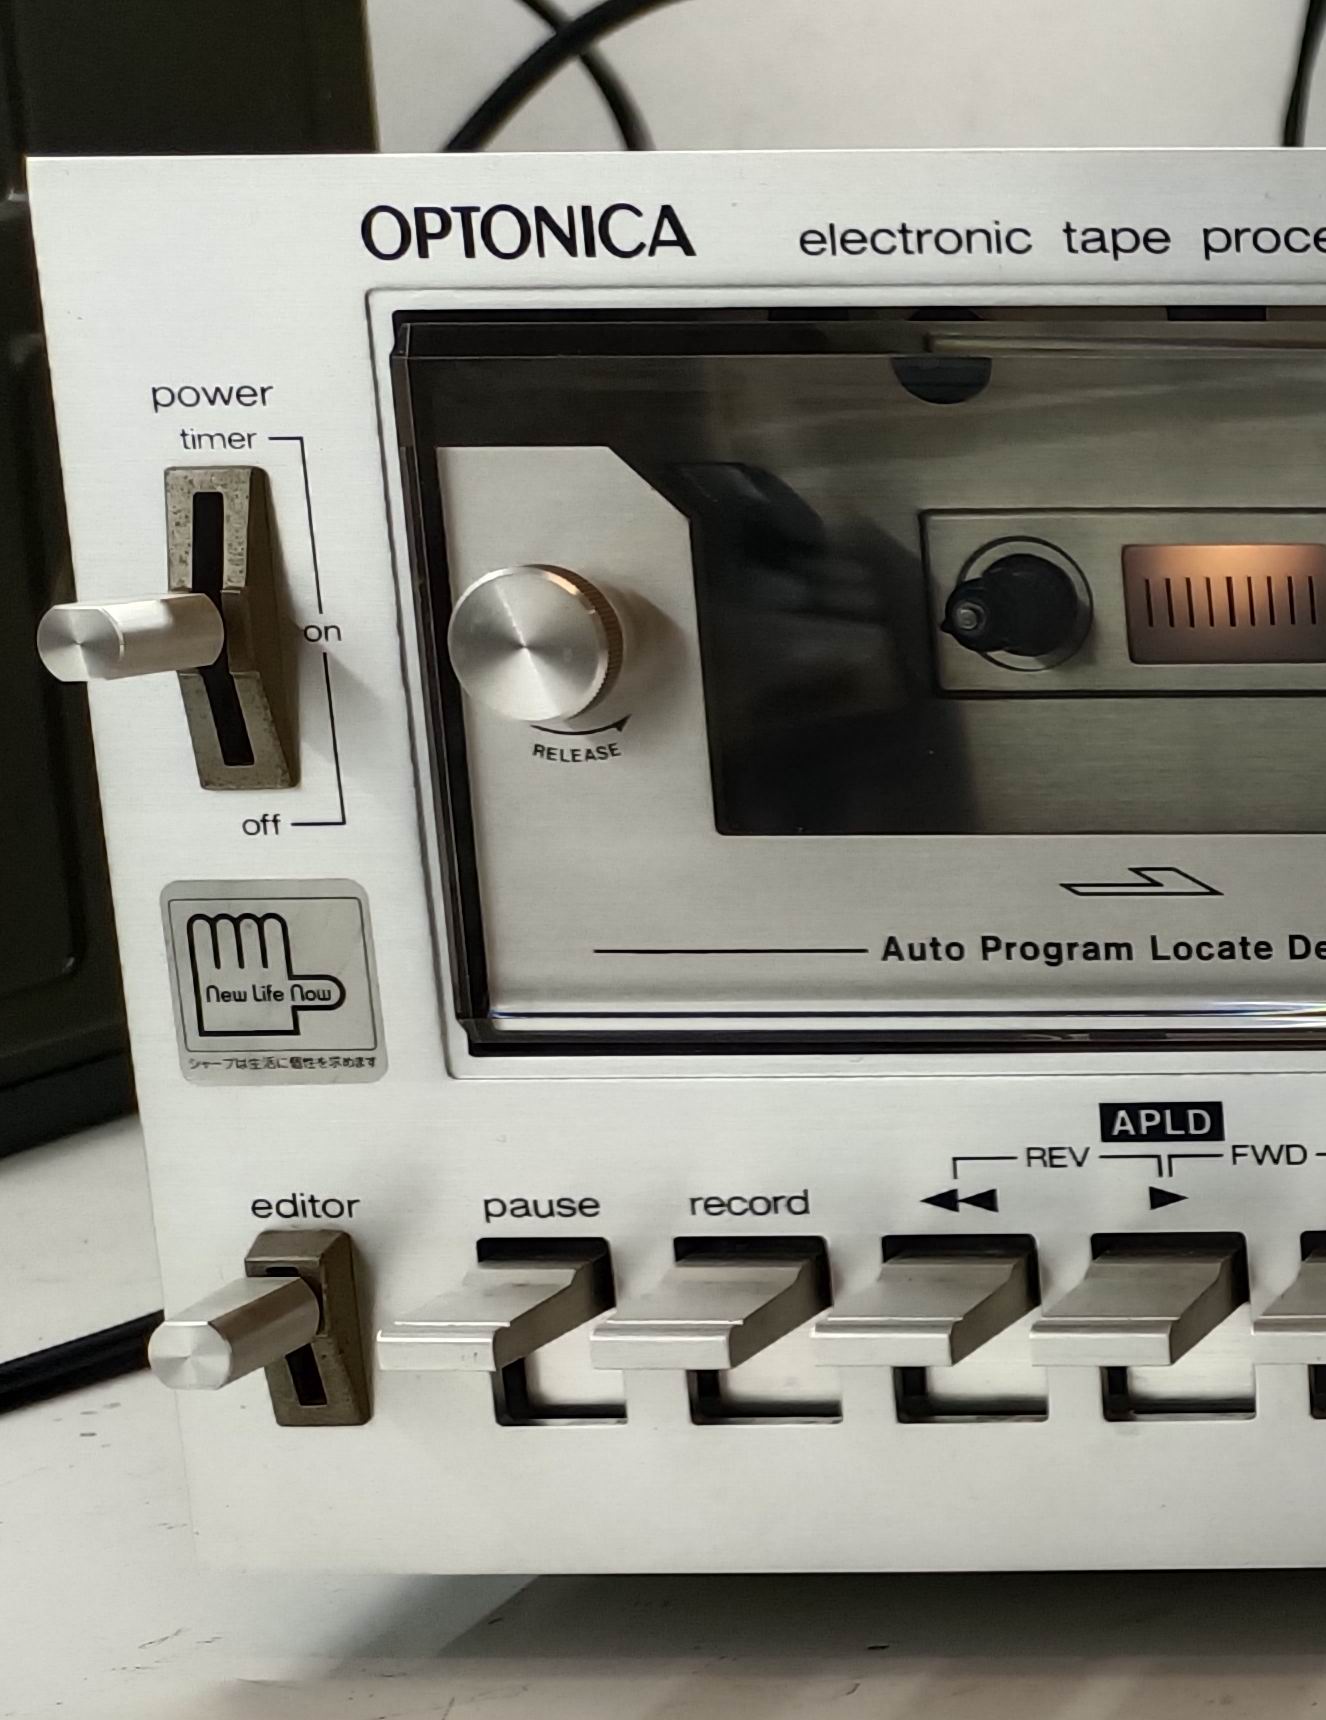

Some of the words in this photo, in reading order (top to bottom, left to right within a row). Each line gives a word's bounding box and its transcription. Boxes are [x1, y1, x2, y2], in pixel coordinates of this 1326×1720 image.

[360, 202, 697, 261] OPTONICA
[799, 220, 1033, 256] electronic
[1062, 221, 1172, 262] tape
[151, 385, 274, 414] power
[179, 429, 257, 450] timer
[303, 623, 342, 643] on
[532, 742, 622, 763] RELEASE
[242, 813, 281, 836] off
[881, 935, 965, 962] Auto
[980, 935, 1134, 967] Program
[1150, 934, 1274, 961] Locate
[205, 984, 248, 1003] New
[251, 984, 285, 1003] Life
[290, 984, 332, 1001] Now
[1112, 1109, 1211, 1136] APLD
[1026, 1146, 1090, 1169] REV
[1231, 1143, 1308, 1166] FWD
[251, 1192, 361, 1219] editor
[483, 1197, 601, 1224] pause
[689, 1188, 811, 1217] record
